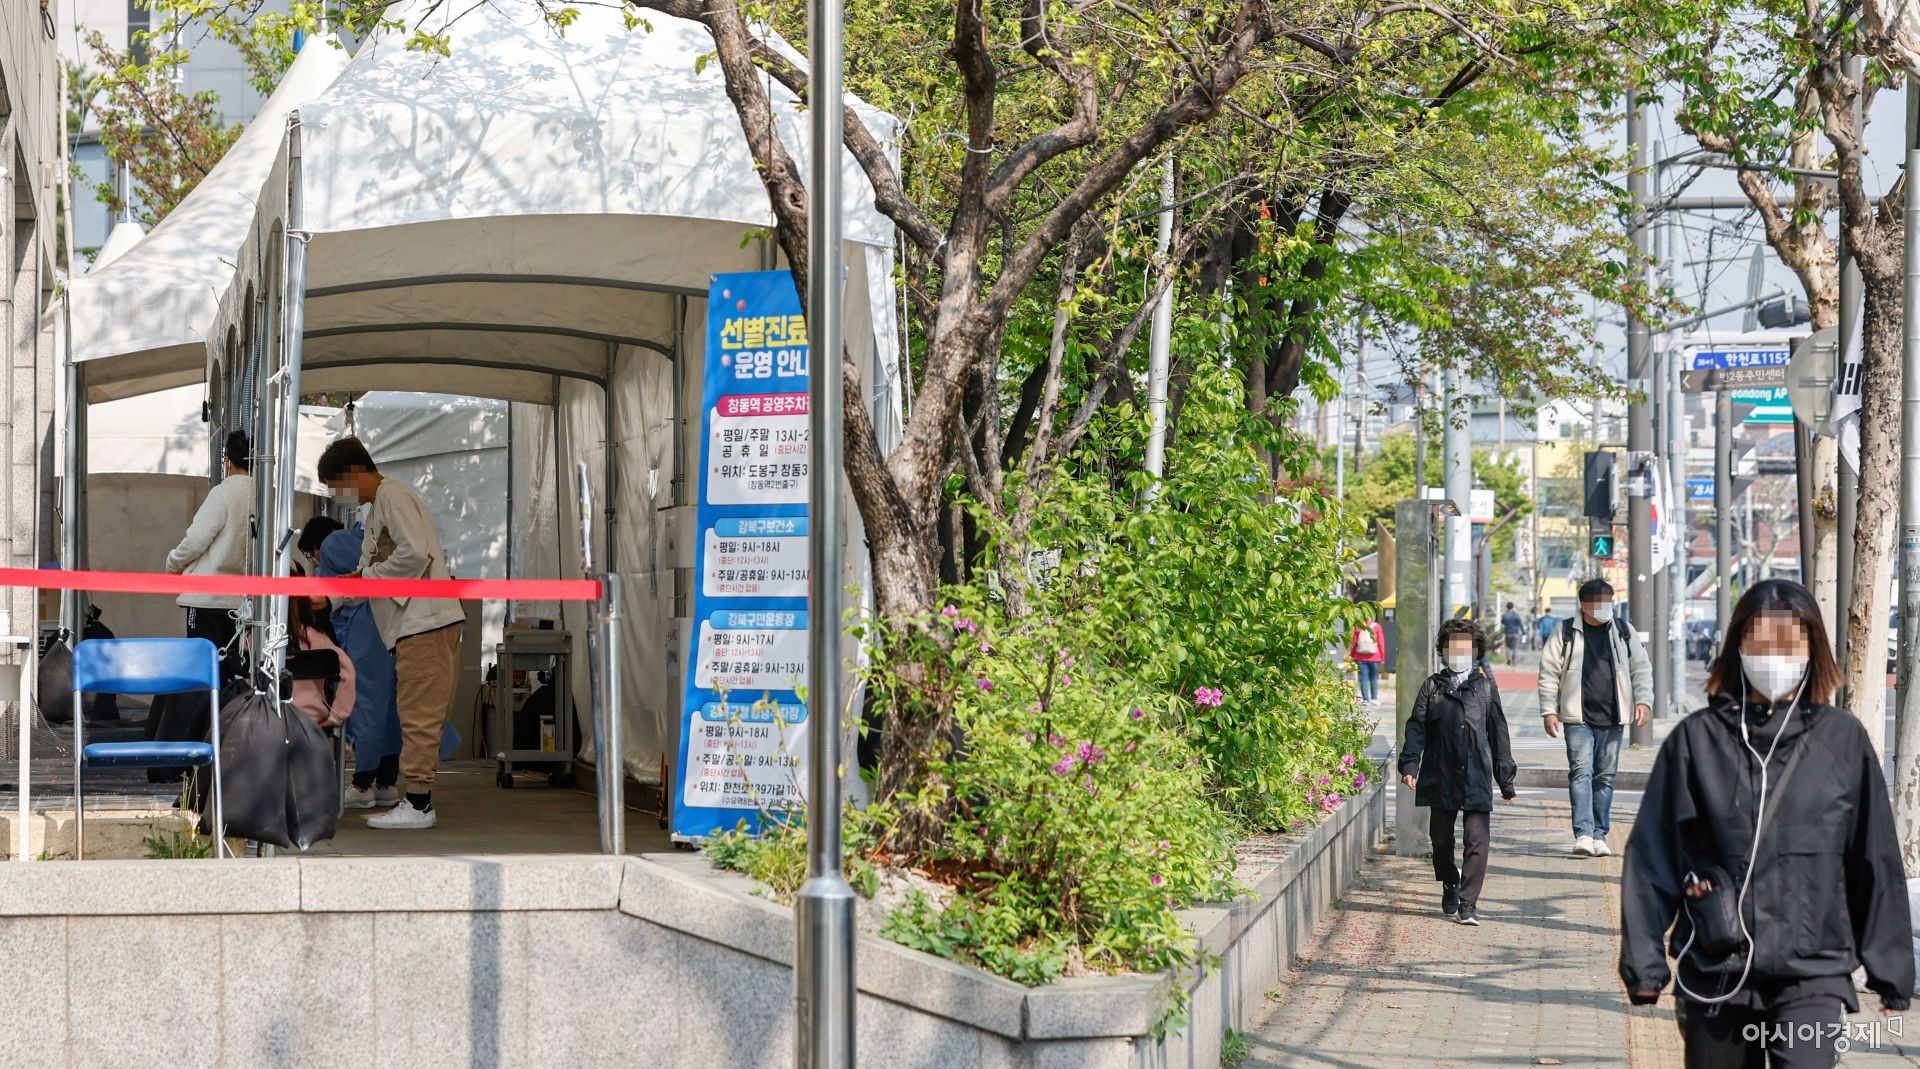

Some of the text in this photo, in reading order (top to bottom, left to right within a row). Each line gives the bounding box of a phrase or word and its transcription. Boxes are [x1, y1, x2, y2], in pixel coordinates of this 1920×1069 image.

[720, 315, 808, 349] 선별진료
[735, 351, 772, 379] 운영
[728, 396, 809, 413] 창동역 공영주차
[723, 428, 769, 442] 평일/주말
[775, 444, 806, 455] (중단시간
[721, 464, 746, 478] 위치:
[748, 464, 778, 478] 도봉구
[748, 480, 799, 490] (창동역2번출구)
[738, 519, 795, 534] 강북구보건소
[719, 541, 780, 553] 평일: 9시-18시
[717, 569, 769, 581] 주말/공휴일:
[728, 612, 795, 627] 강북구민운동장
[714, 633, 774, 645] 평일: 9시-17시
[711, 661, 804, 674] 주말/공휴일: 9시-13시
[705, 725, 769, 738] 평일: 9시-18시
[702, 753, 756, 766] 주말/공일:
[699, 781, 721, 793] 위치:
